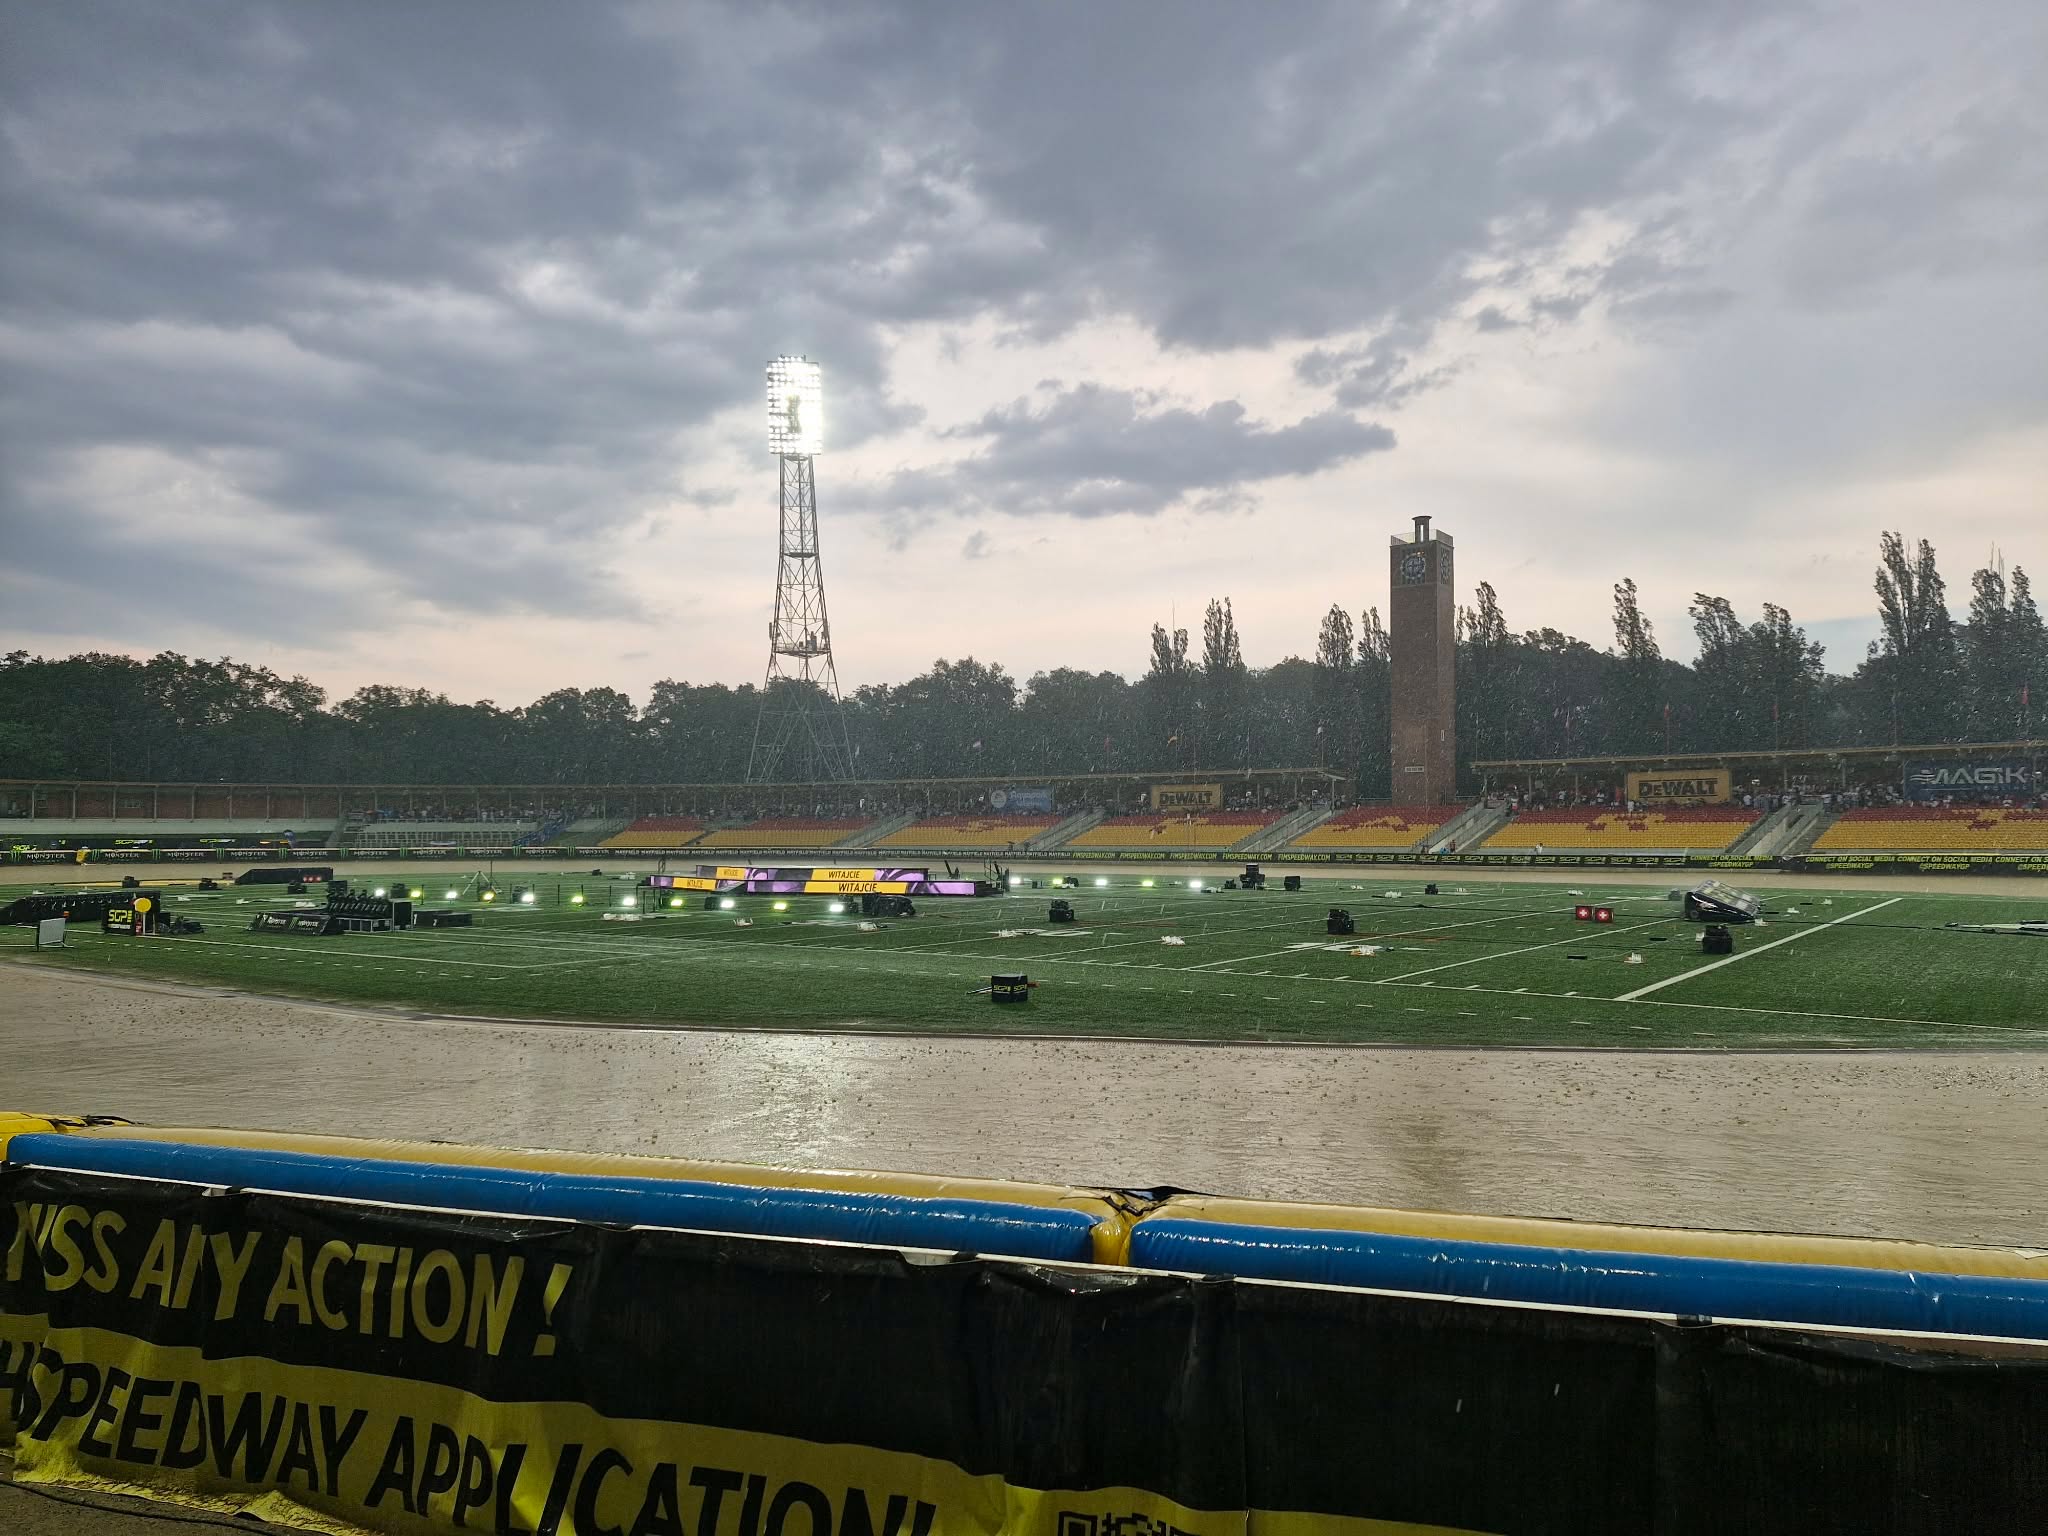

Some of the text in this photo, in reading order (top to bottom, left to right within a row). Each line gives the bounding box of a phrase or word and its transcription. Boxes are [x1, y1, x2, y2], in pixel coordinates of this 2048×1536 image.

[828, 870, 860, 879] WITAJCIE
[838, 883, 877, 893] WITAJCIE
[298, 919, 319, 928] MONSTER
[264, 1236, 525, 1356] ACTION
